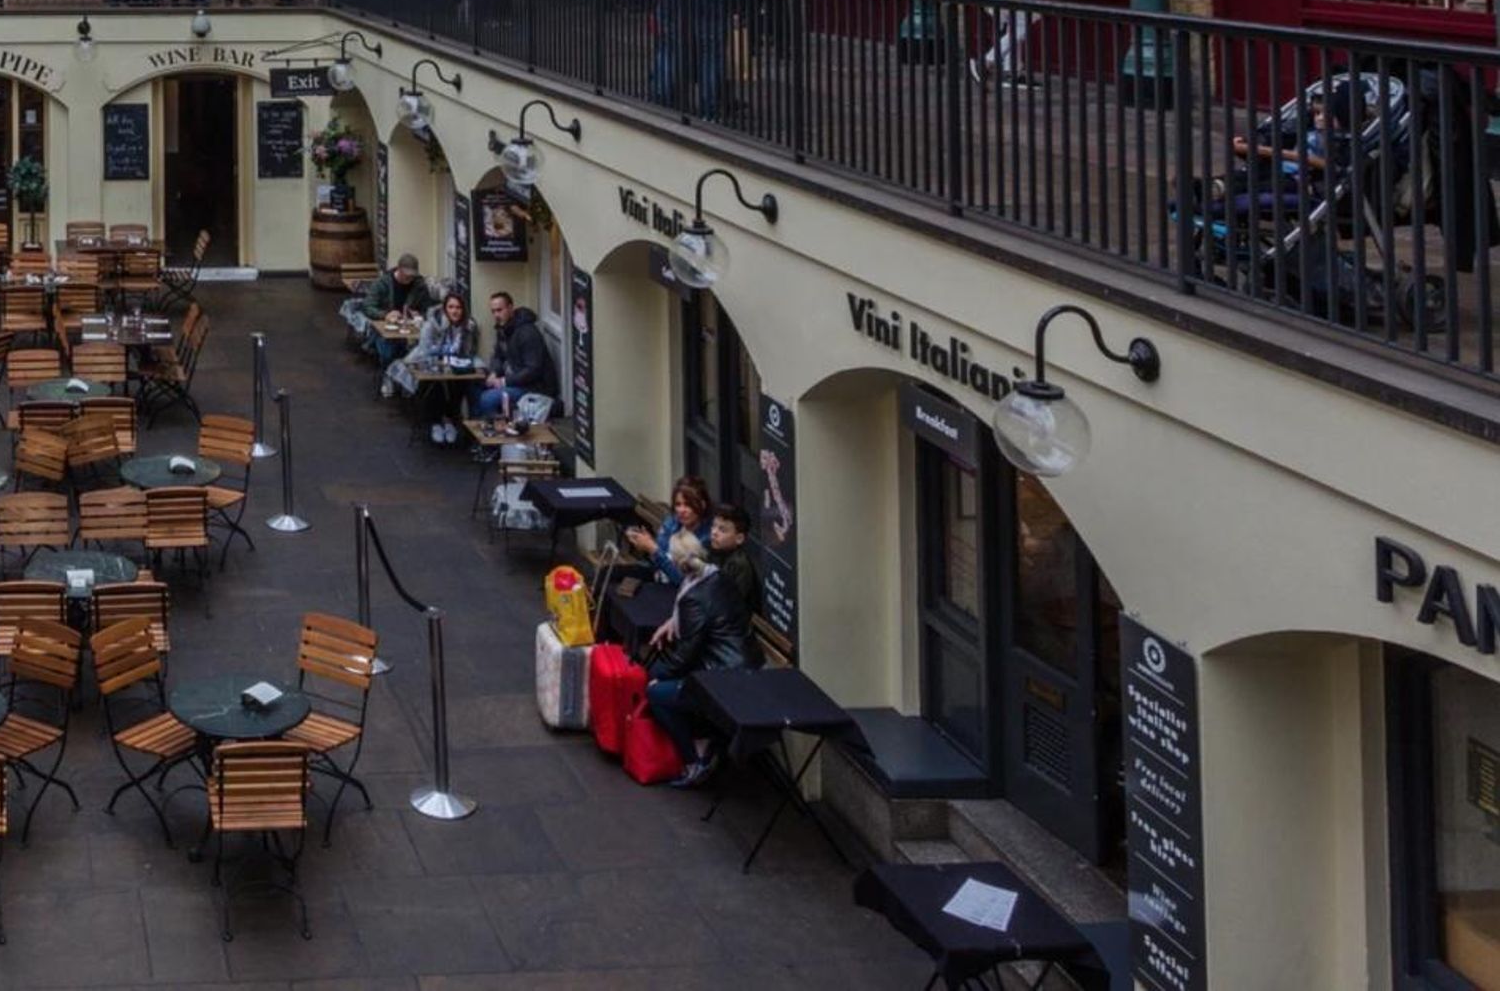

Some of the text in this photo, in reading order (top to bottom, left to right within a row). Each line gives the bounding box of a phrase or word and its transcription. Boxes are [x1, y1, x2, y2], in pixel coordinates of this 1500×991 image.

[0, 51, 53, 86] PIPE
[149, 47, 255, 68] WINE BAR
[288, 74, 320, 90] Exit
[618, 186, 684, 239] Vini Itali
[847, 292, 901, 350] Vini
[915, 405, 958, 439] Breakfast
[1128, 684, 1187, 732] Specialist
[1136, 704, 1178, 741] Italian
[1128, 714, 1190, 765] wine shop
[1134, 758, 1186, 802] Free local
[1140, 777, 1181, 815] delivery
[1131, 810, 1194, 867] Free glass
[1150, 838, 1176, 867] hire
[1144, 934, 1189, 981] Special
[1148, 955, 1185, 991] offers
